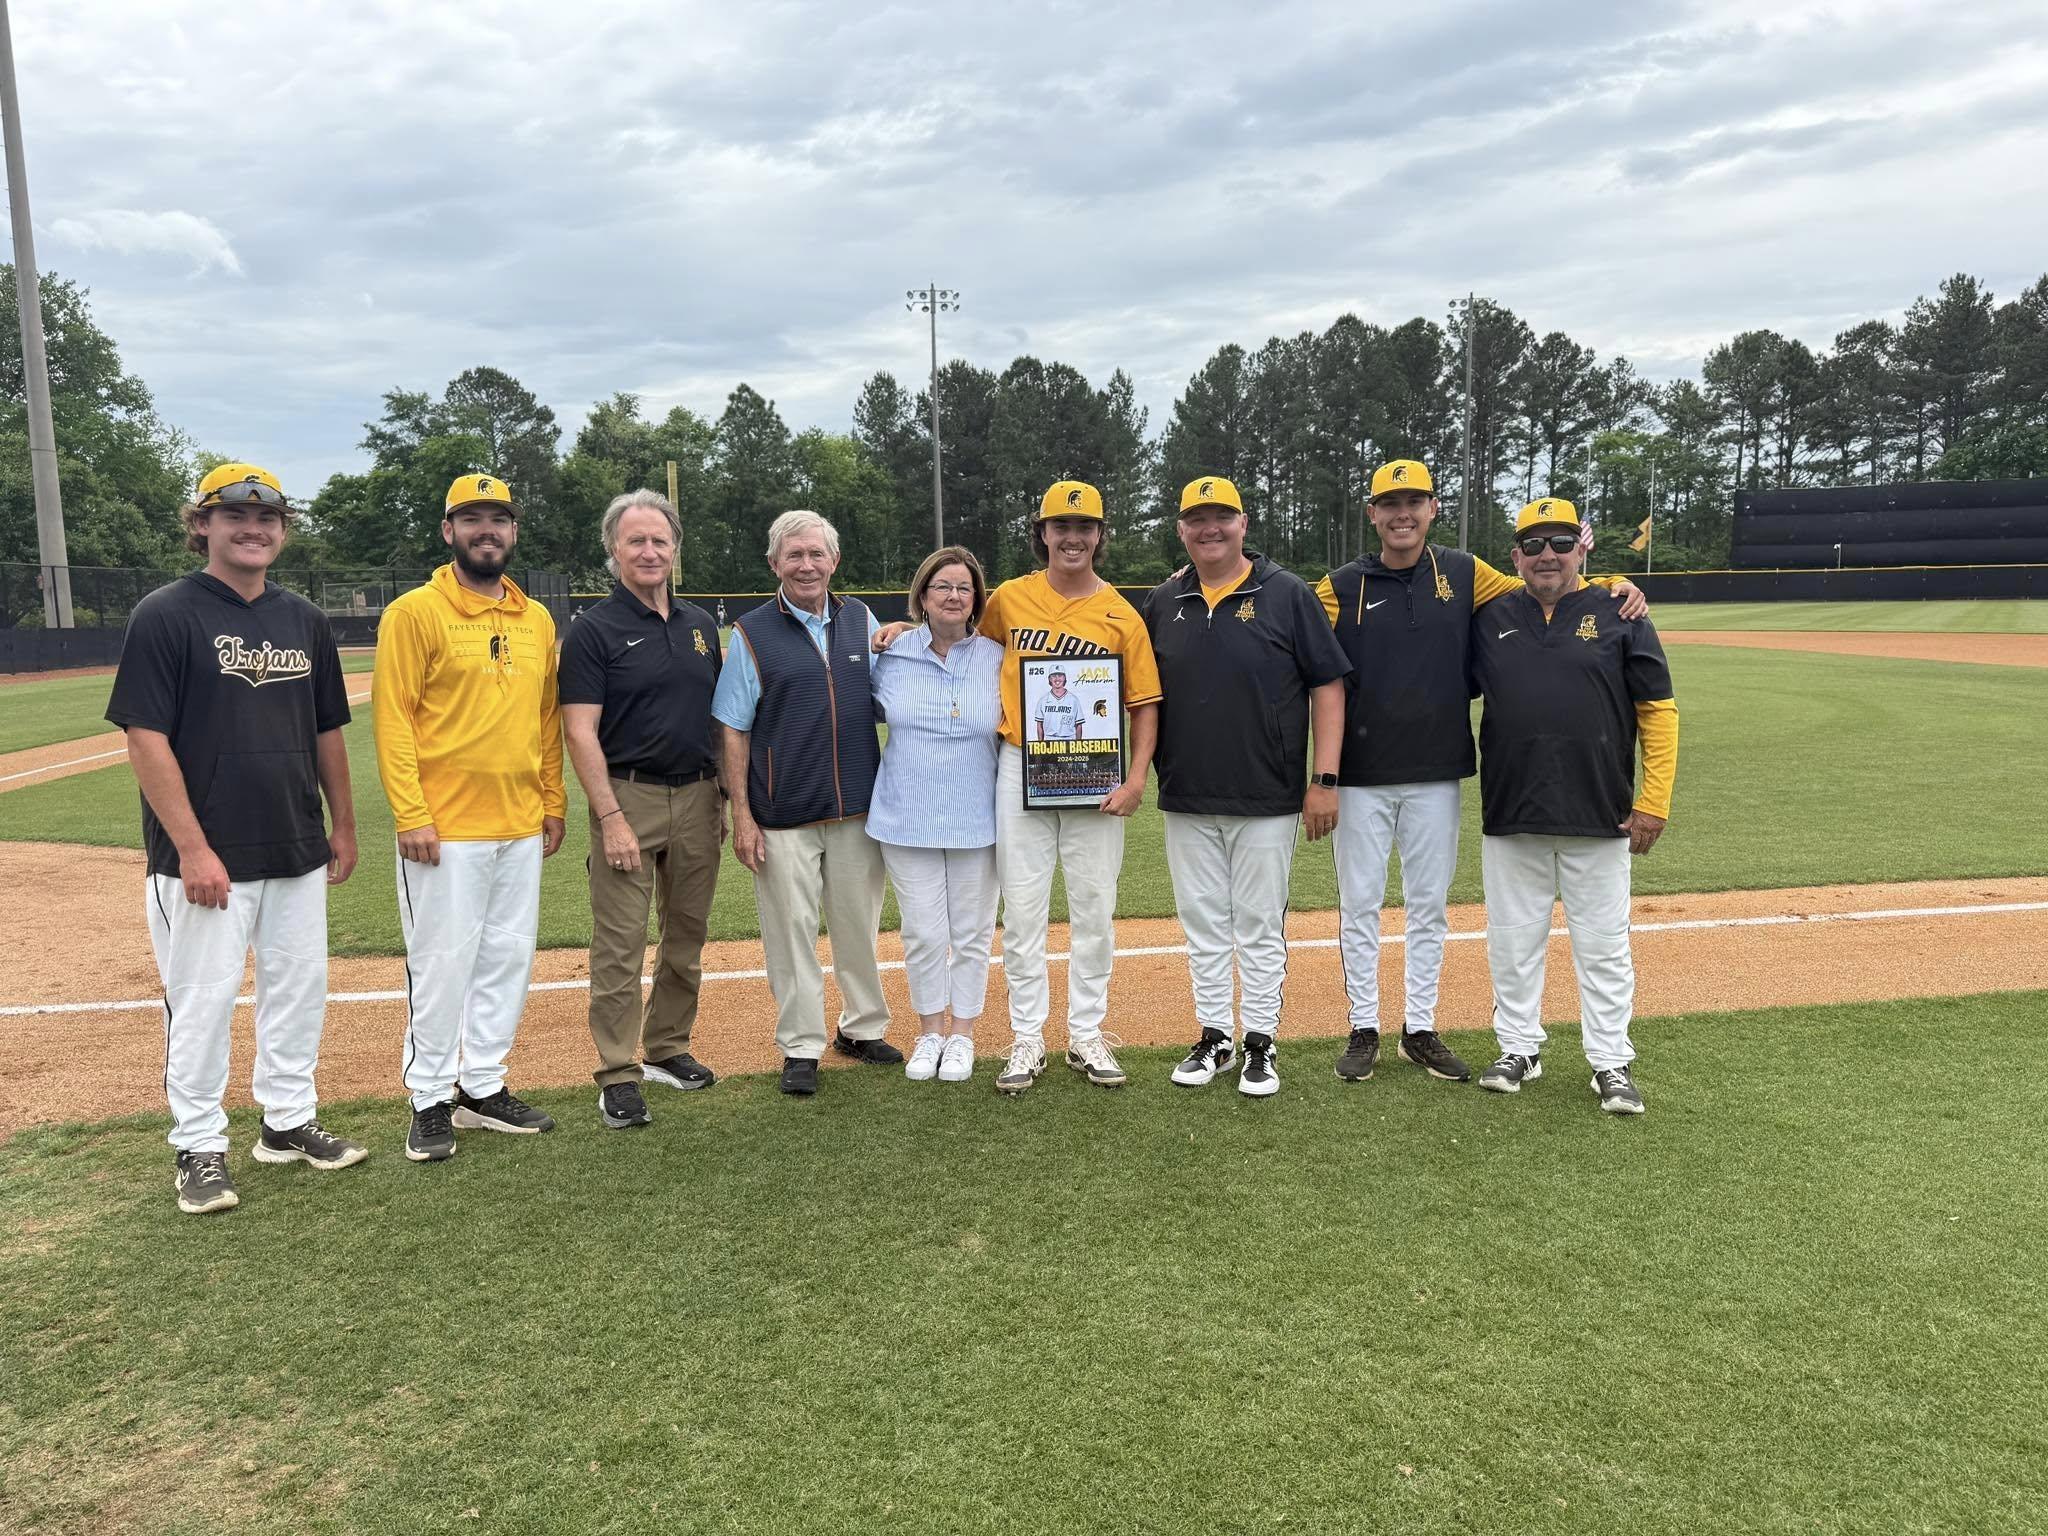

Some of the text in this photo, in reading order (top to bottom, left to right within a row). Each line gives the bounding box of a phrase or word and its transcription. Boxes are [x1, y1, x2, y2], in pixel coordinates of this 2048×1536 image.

[214, 635, 309, 680] Trojans
[1028, 667, 1045, 676] #26
[1077, 666, 1110, 679] JACK
[1044, 705, 1072, 713] TROJANS
[1028, 739, 1119, 755] TROJAN BASEBALL
